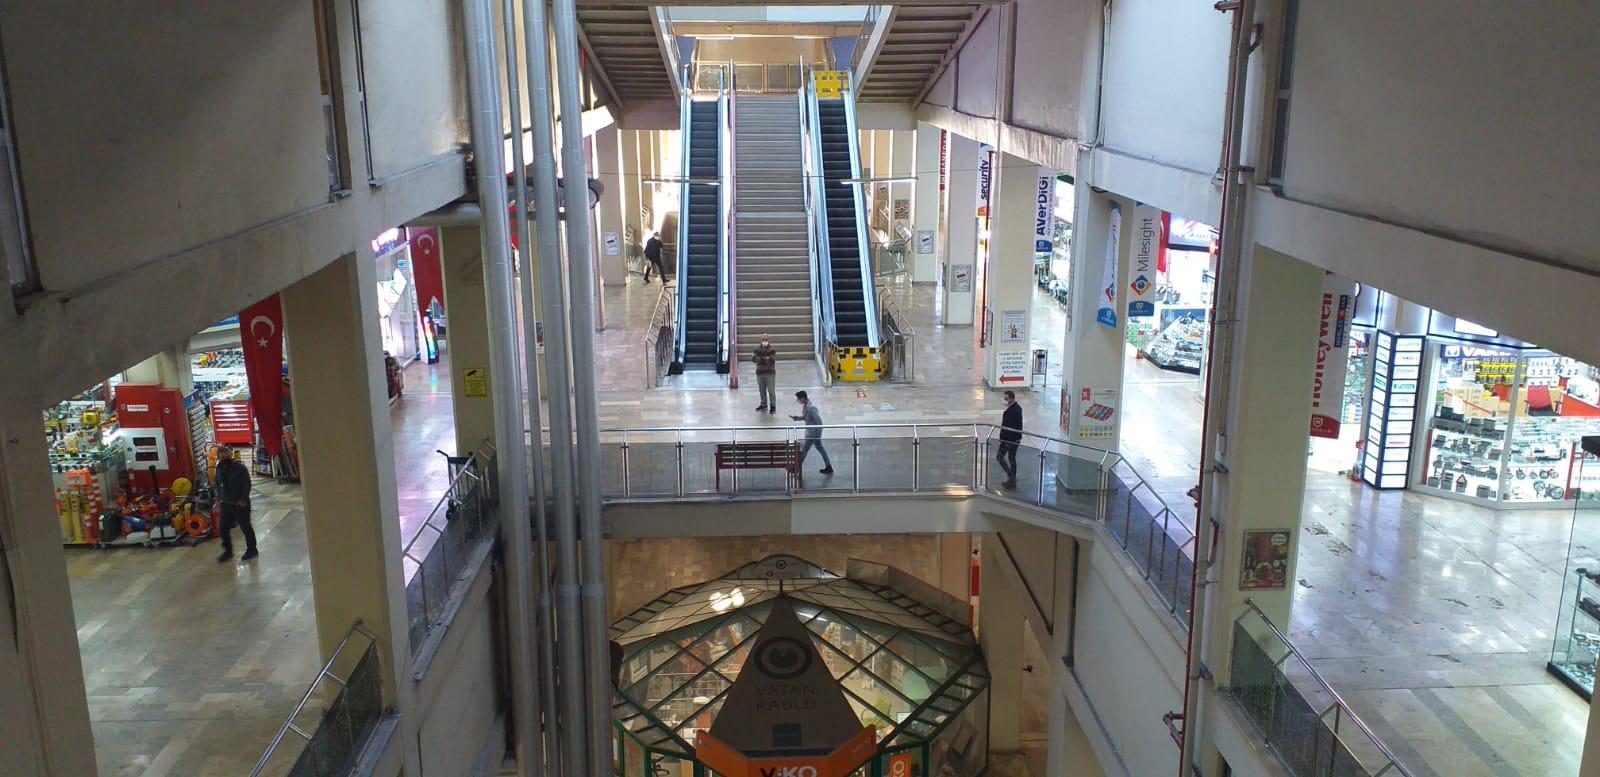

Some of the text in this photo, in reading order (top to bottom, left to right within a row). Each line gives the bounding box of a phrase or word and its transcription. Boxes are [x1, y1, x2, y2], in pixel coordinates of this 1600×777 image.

[1137, 217, 1155, 272] Milesight
[754, 685, 816, 696] VATAN
[755, 699, 817, 711] KABLO
